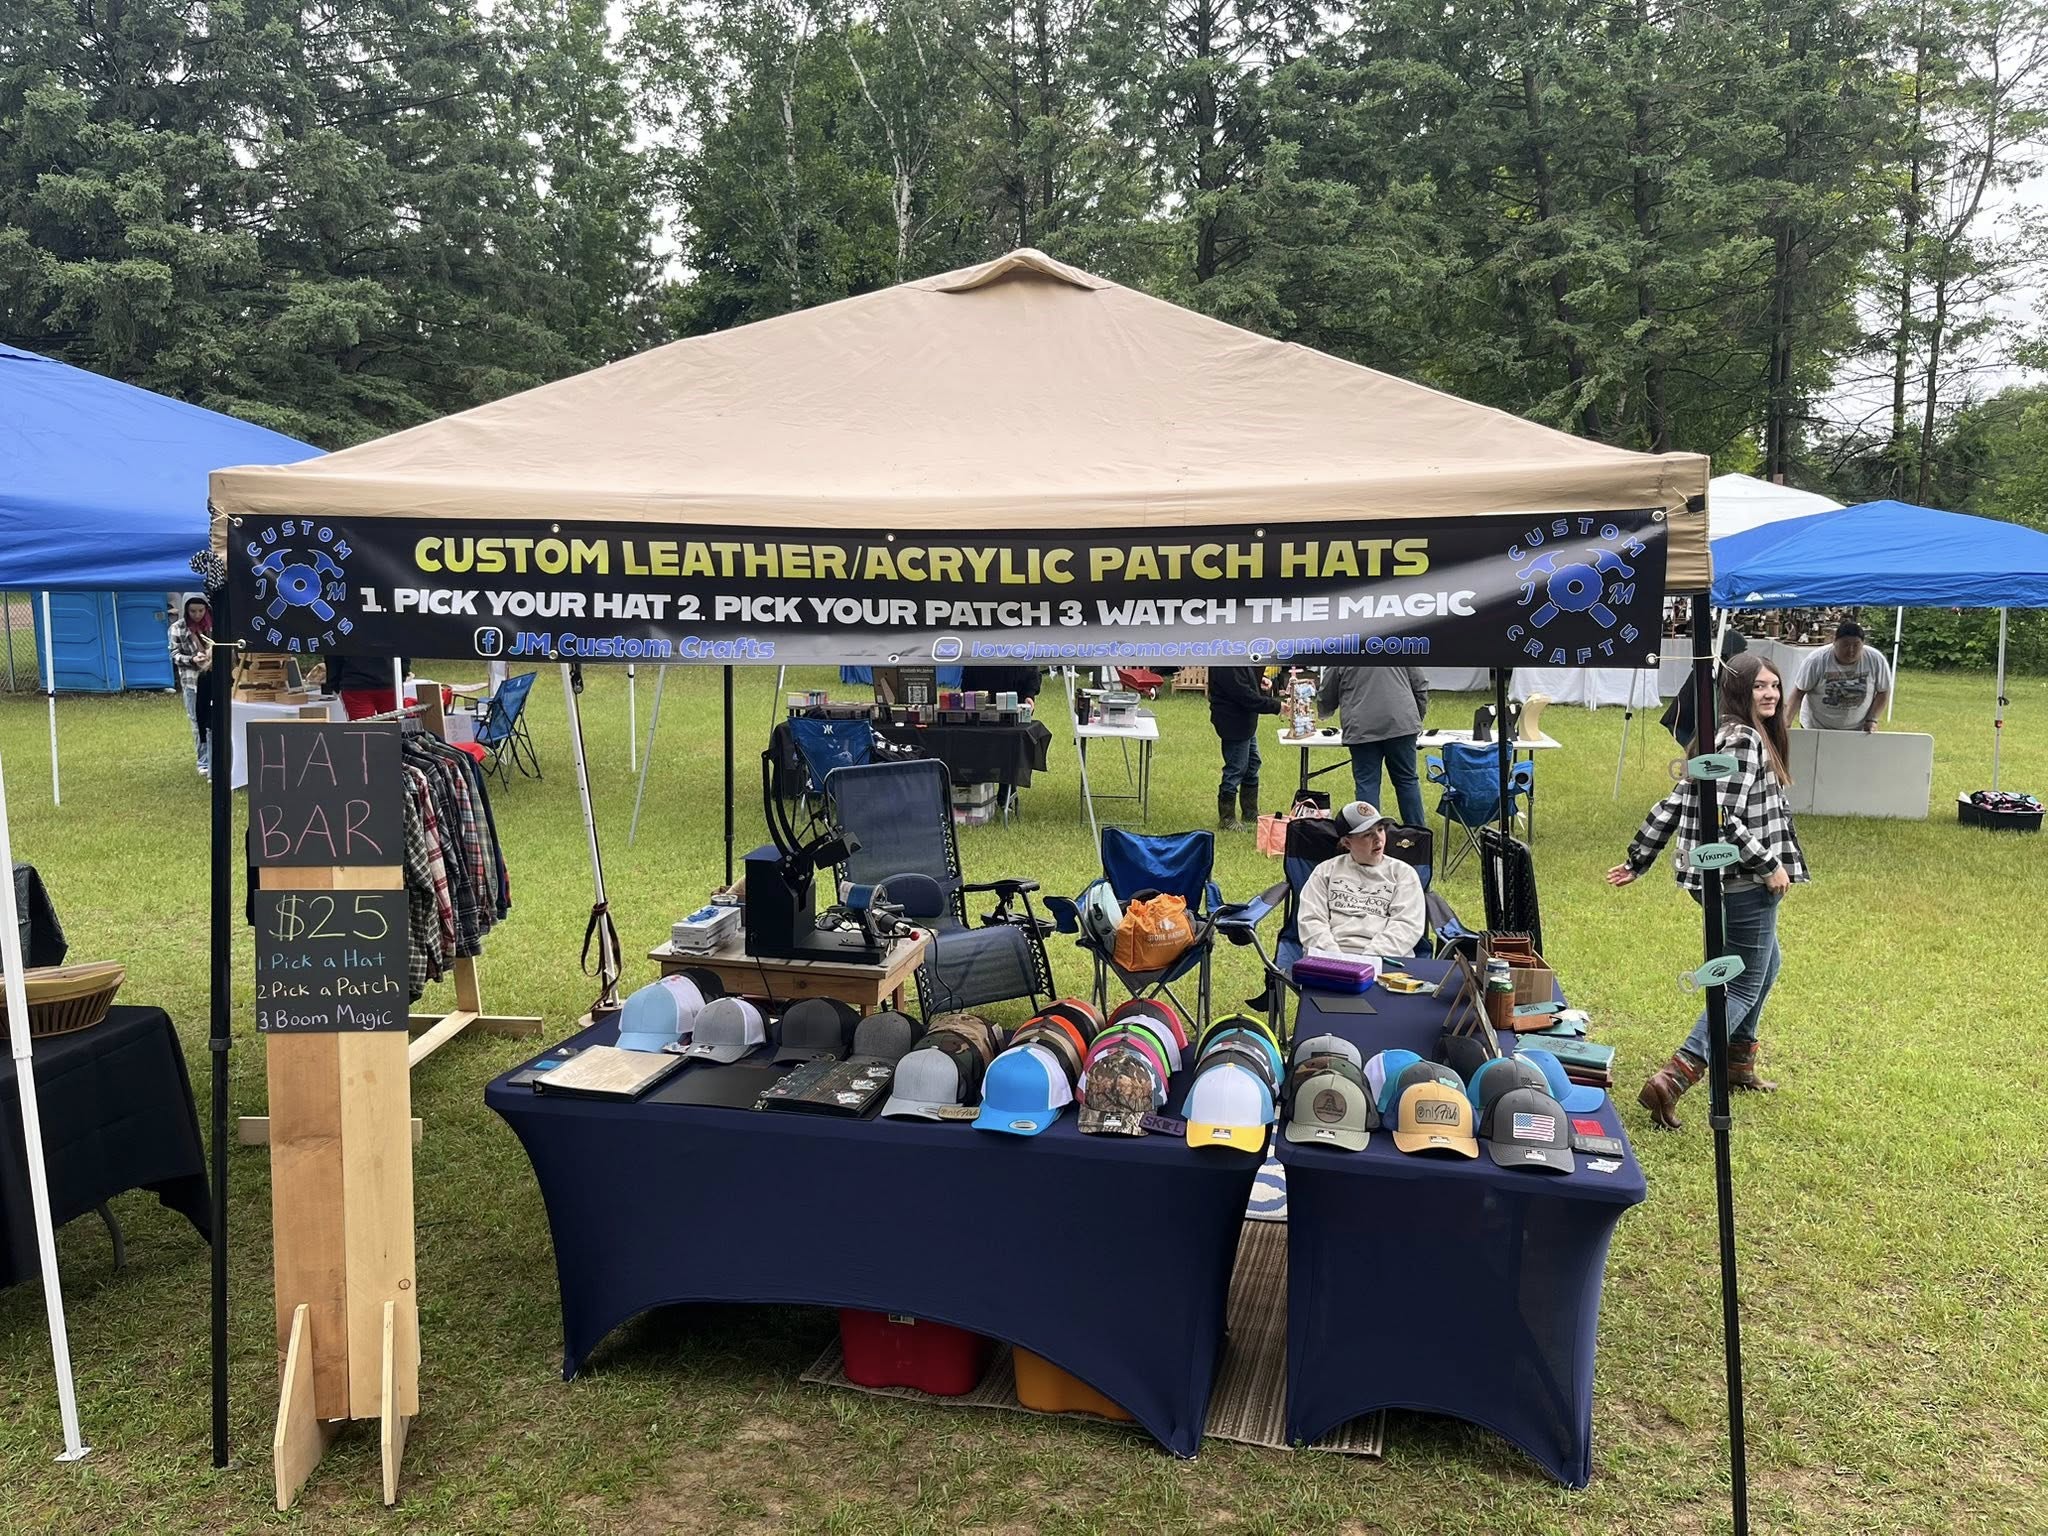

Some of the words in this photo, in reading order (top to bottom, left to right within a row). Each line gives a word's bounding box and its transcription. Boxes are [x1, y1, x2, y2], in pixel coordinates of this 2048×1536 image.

[246, 520, 353, 560] CUSTOM
[1507, 517, 1646, 561] CUSTOM
[415, 537, 609, 575] CUSTOM
[621, 541, 1075, 585] LEATHER/ACRYLIC
[1089, 542, 1264, 583] PATCH
[1280, 538, 1430, 578] HATS
[254, 578, 267, 600] J
[326, 581, 347, 601] M
[360, 587, 388, 613] 1.
[394, 588, 479, 615] PICK
[485, 591, 586, 617] YOUR
[593, 592, 671, 620] HAT
[677, 594, 707, 621] 2.
[715, 595, 803, 623] PICK
[808, 597, 918, 625] YOUR
[925, 600, 1051, 627] PATCH
[1058, 600, 1088, 627] 3.
[1096, 598, 1237, 626] WATCH
[1245, 597, 1330, 624] THE
[1338, 590, 1477, 620] MAGIC
[1517, 581, 1536, 605] J
[1607, 582, 1636, 605] M
[252, 616, 354, 652] CRAFTS
[508, 632, 552, 656] JM
[557, 633, 672, 658] Custom
[679, 636, 775, 659] Crafts
[971, 633, 1430, 661] lovejmcustomcrafts@gmail.com
[1507, 623, 1639, 664] CRAFTS
[259, 731, 393, 792] HAT
[259, 800, 383, 858] BAR
[268, 895, 388, 941] $25
[272, 953, 312, 969] Pick
[324, 957, 336, 968] a
[344, 949, 385, 968] Hat
[272, 981, 310, 998] Pick
[320, 986, 331, 996] a
[337, 974, 399, 996] Patch
[276, 1009, 328, 1029] Boom
[337, 1004, 393, 1031] Magic
